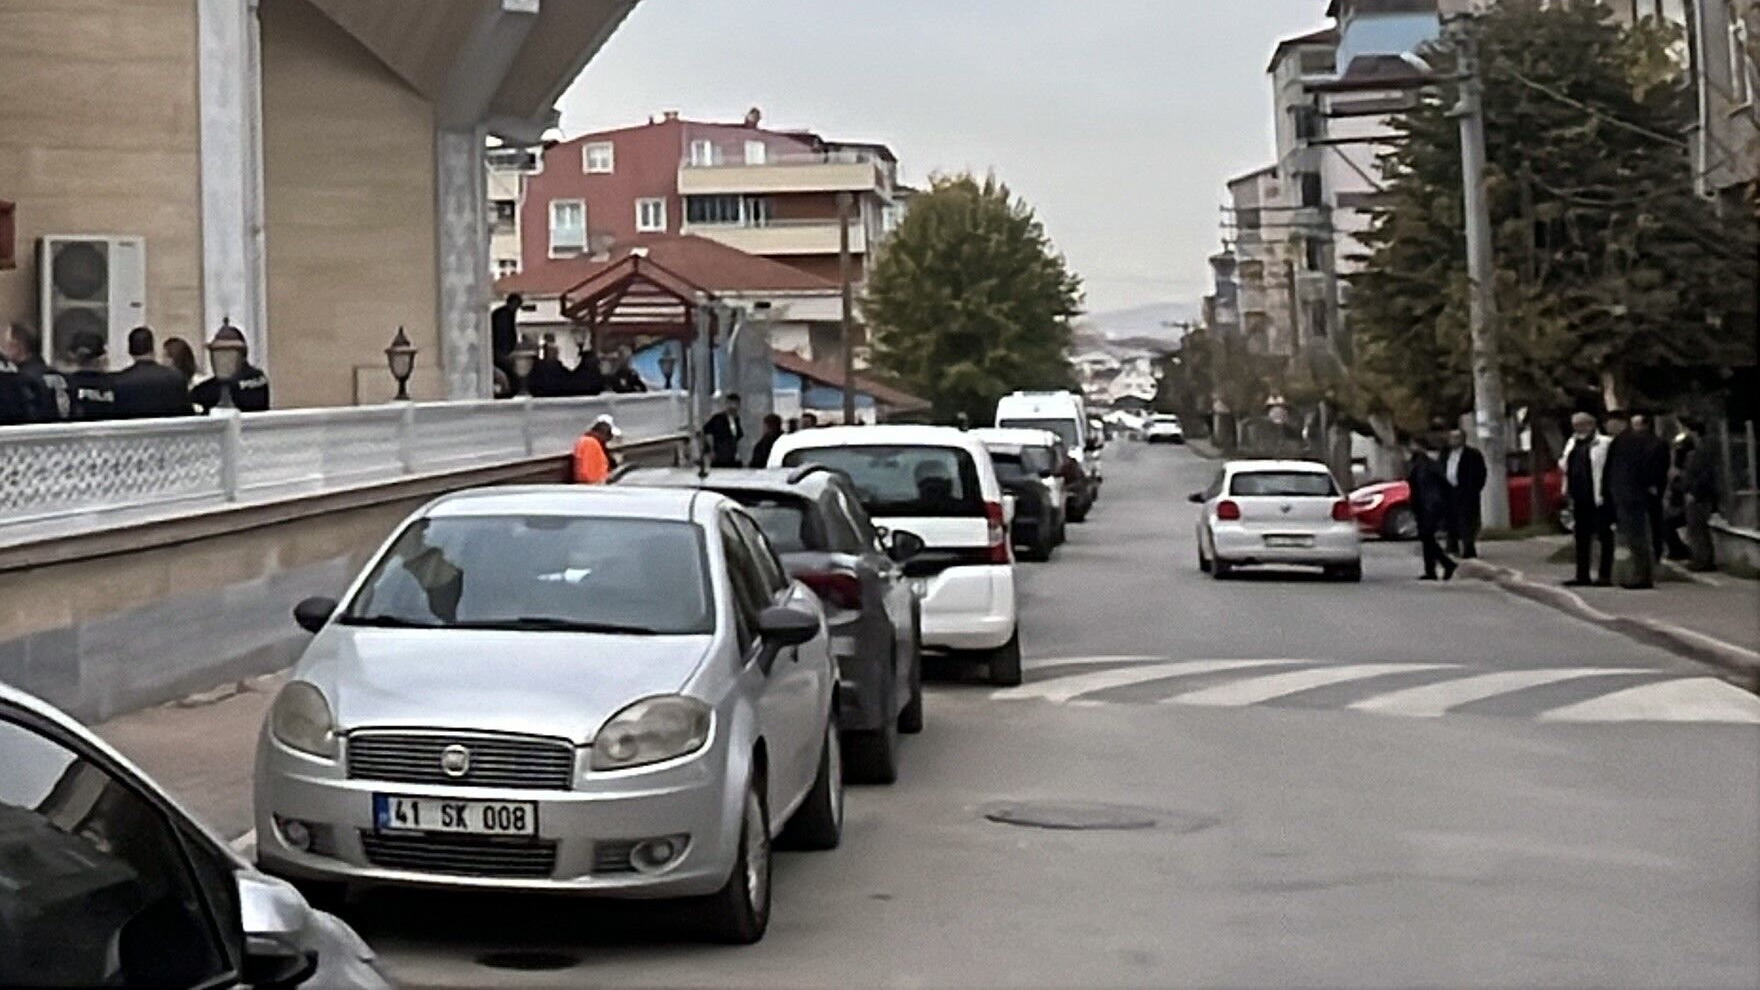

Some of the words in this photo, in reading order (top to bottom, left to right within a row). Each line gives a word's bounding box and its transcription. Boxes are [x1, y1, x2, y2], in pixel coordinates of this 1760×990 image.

[395, 800, 419, 825] 41
[441, 803, 467, 829] SK
[483, 805, 526, 831] 008
